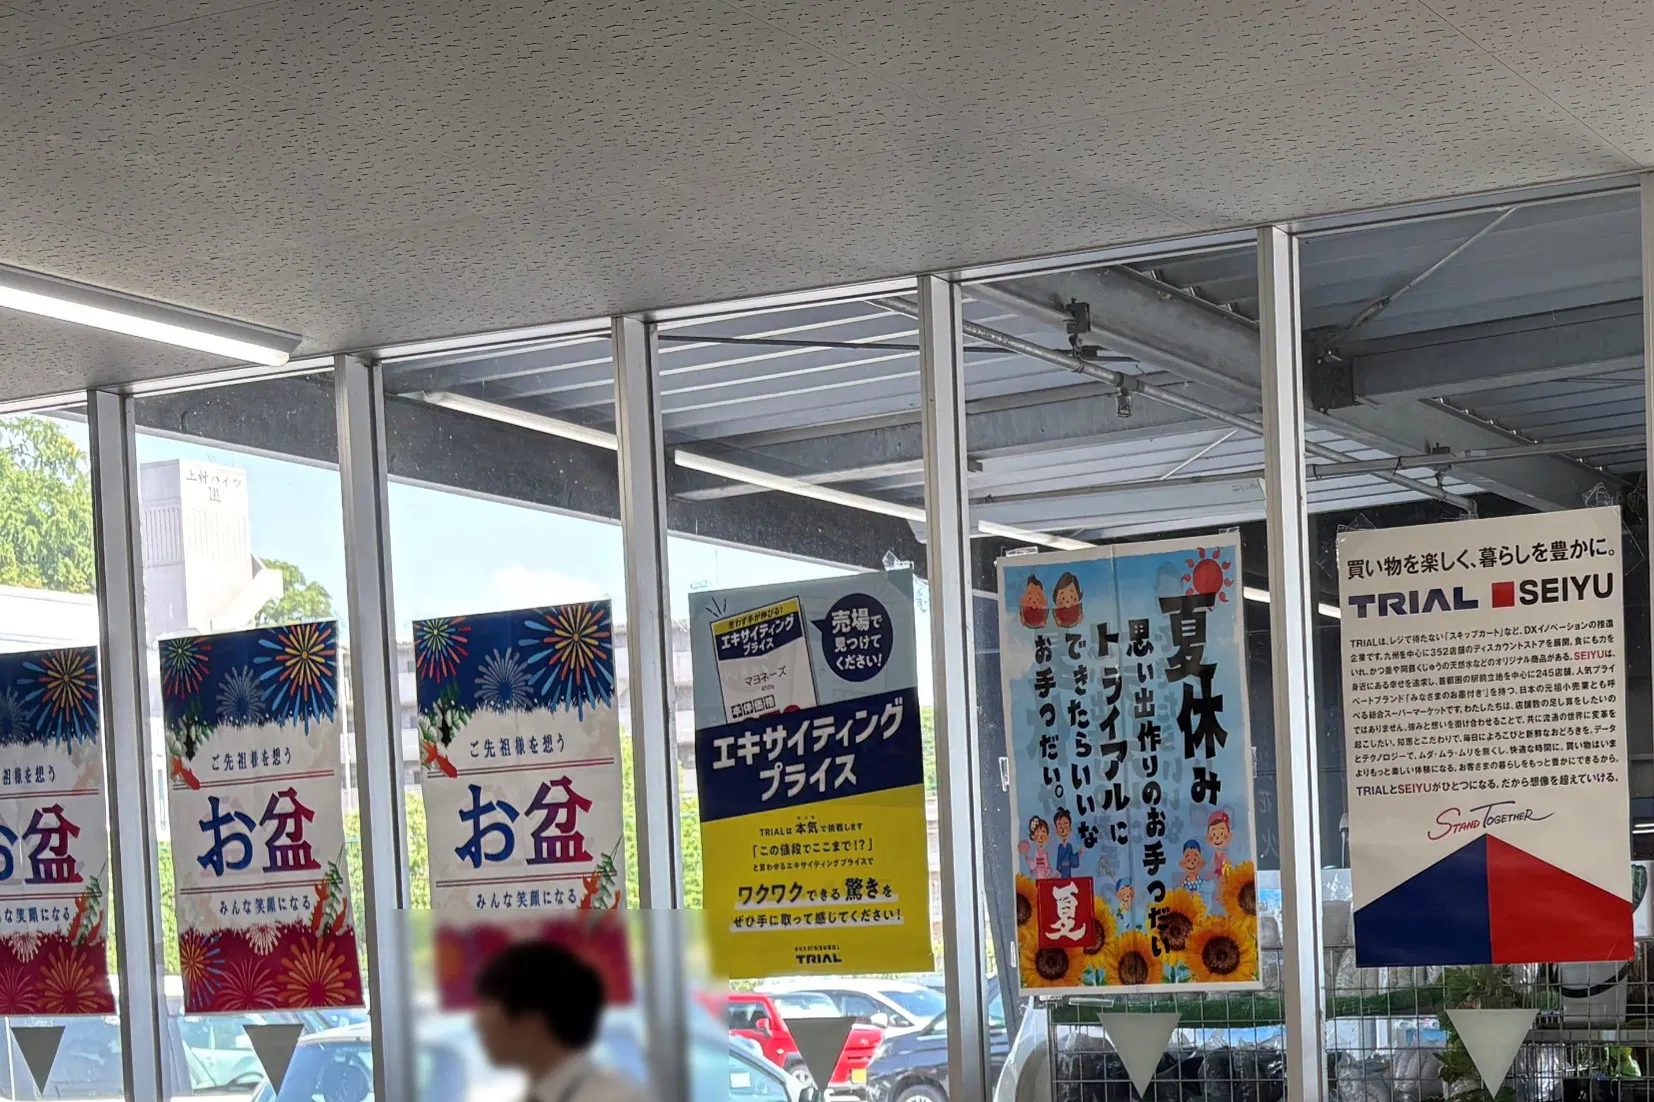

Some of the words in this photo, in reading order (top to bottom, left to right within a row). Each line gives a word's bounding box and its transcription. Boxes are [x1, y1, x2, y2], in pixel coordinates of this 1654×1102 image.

[1347, 537, 1615, 580] 買い物を楽しく、暮らしを豊かに。
[1349, 586, 1479, 618] TRIAL
[1519, 573, 1614, 605] SEIYU
[721, 616, 795, 649] エキサイティング
[832, 608, 883, 634] 売場で
[743, 638, 775, 656] プライス
[835, 634, 882, 652] 見つけて
[744, 666, 787, 686] マヨネーズ
[1159, 592, 1228, 805] 夏休み
[712, 697, 904, 769] エキサイティング
[1034, 635, 1064, 798] お手つだい。
[470, 733, 565, 758] ご先祖様を想う
[1065, 634, 1098, 848] できたらいいな
[1097, 623, 1130, 845] トライアルに
[211, 747, 292, 771] ご先祖様を想う
[759, 754, 857, 801] プライス
[1127, 619, 1170, 957] 思い出作りのお手つだい
[196, 786, 322, 877] お盆
[454, 775, 594, 869] お盆
[753, 857, 875, 872] と言わせるエキサイティングプライスで
[219, 895, 311, 915] みんな笑顔になる
[476, 889, 577, 909] みんな笑顔になる
[738, 877, 893, 905] ワクワクできる驚きを
[0, 906, 71, 923] な笑顔になる
[1046, 882, 1085, 941] 夏
[796, 954, 842, 964] TRIAL
